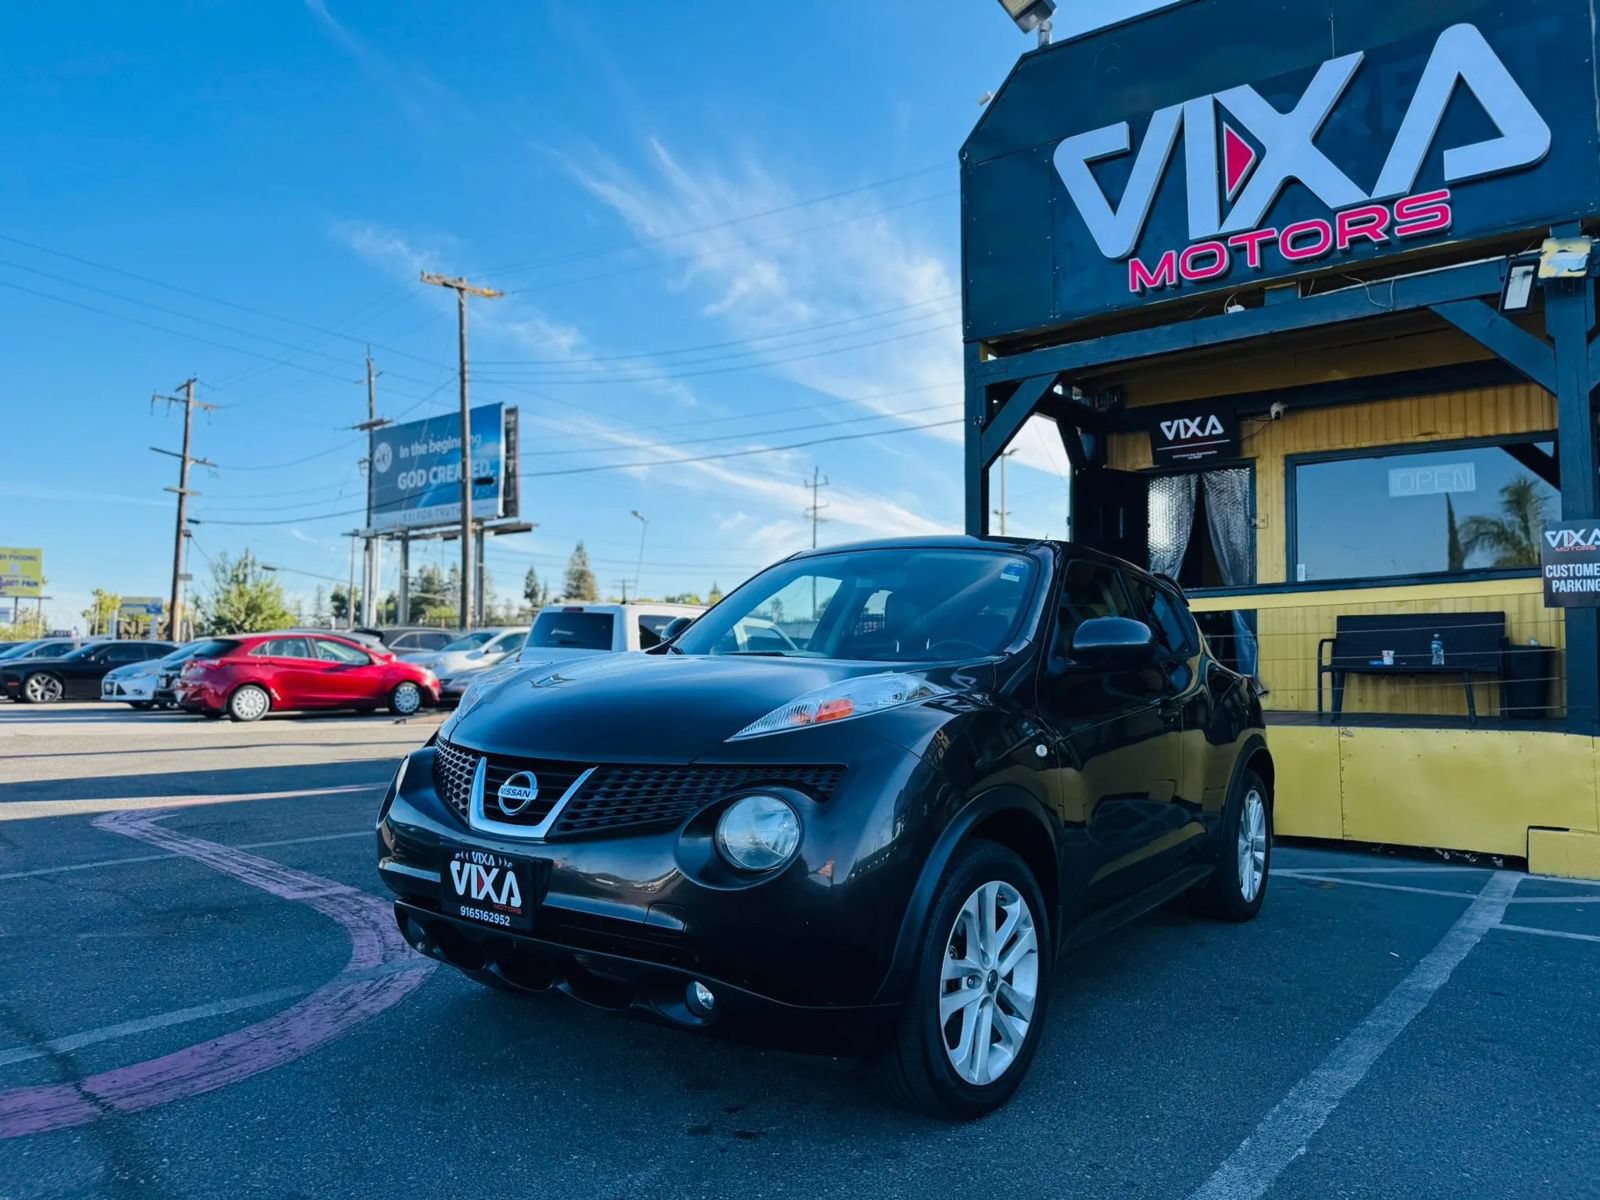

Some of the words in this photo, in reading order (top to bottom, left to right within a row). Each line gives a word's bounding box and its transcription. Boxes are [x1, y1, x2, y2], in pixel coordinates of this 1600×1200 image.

[1053, 22, 1552, 259] VIXA
[1128, 188, 1452, 294] MOTORS
[1160, 414, 1224, 441] VIXA
[411, 441, 427, 456] the
[397, 468, 427, 491] GOD
[1395, 466, 1472, 492] OPEN
[500, 786, 531, 798] NISSAN
[471, 851, 496, 867] VIXA
[450, 860, 522, 907] VIXA
[460, 905, 511, 927] 9165162952
